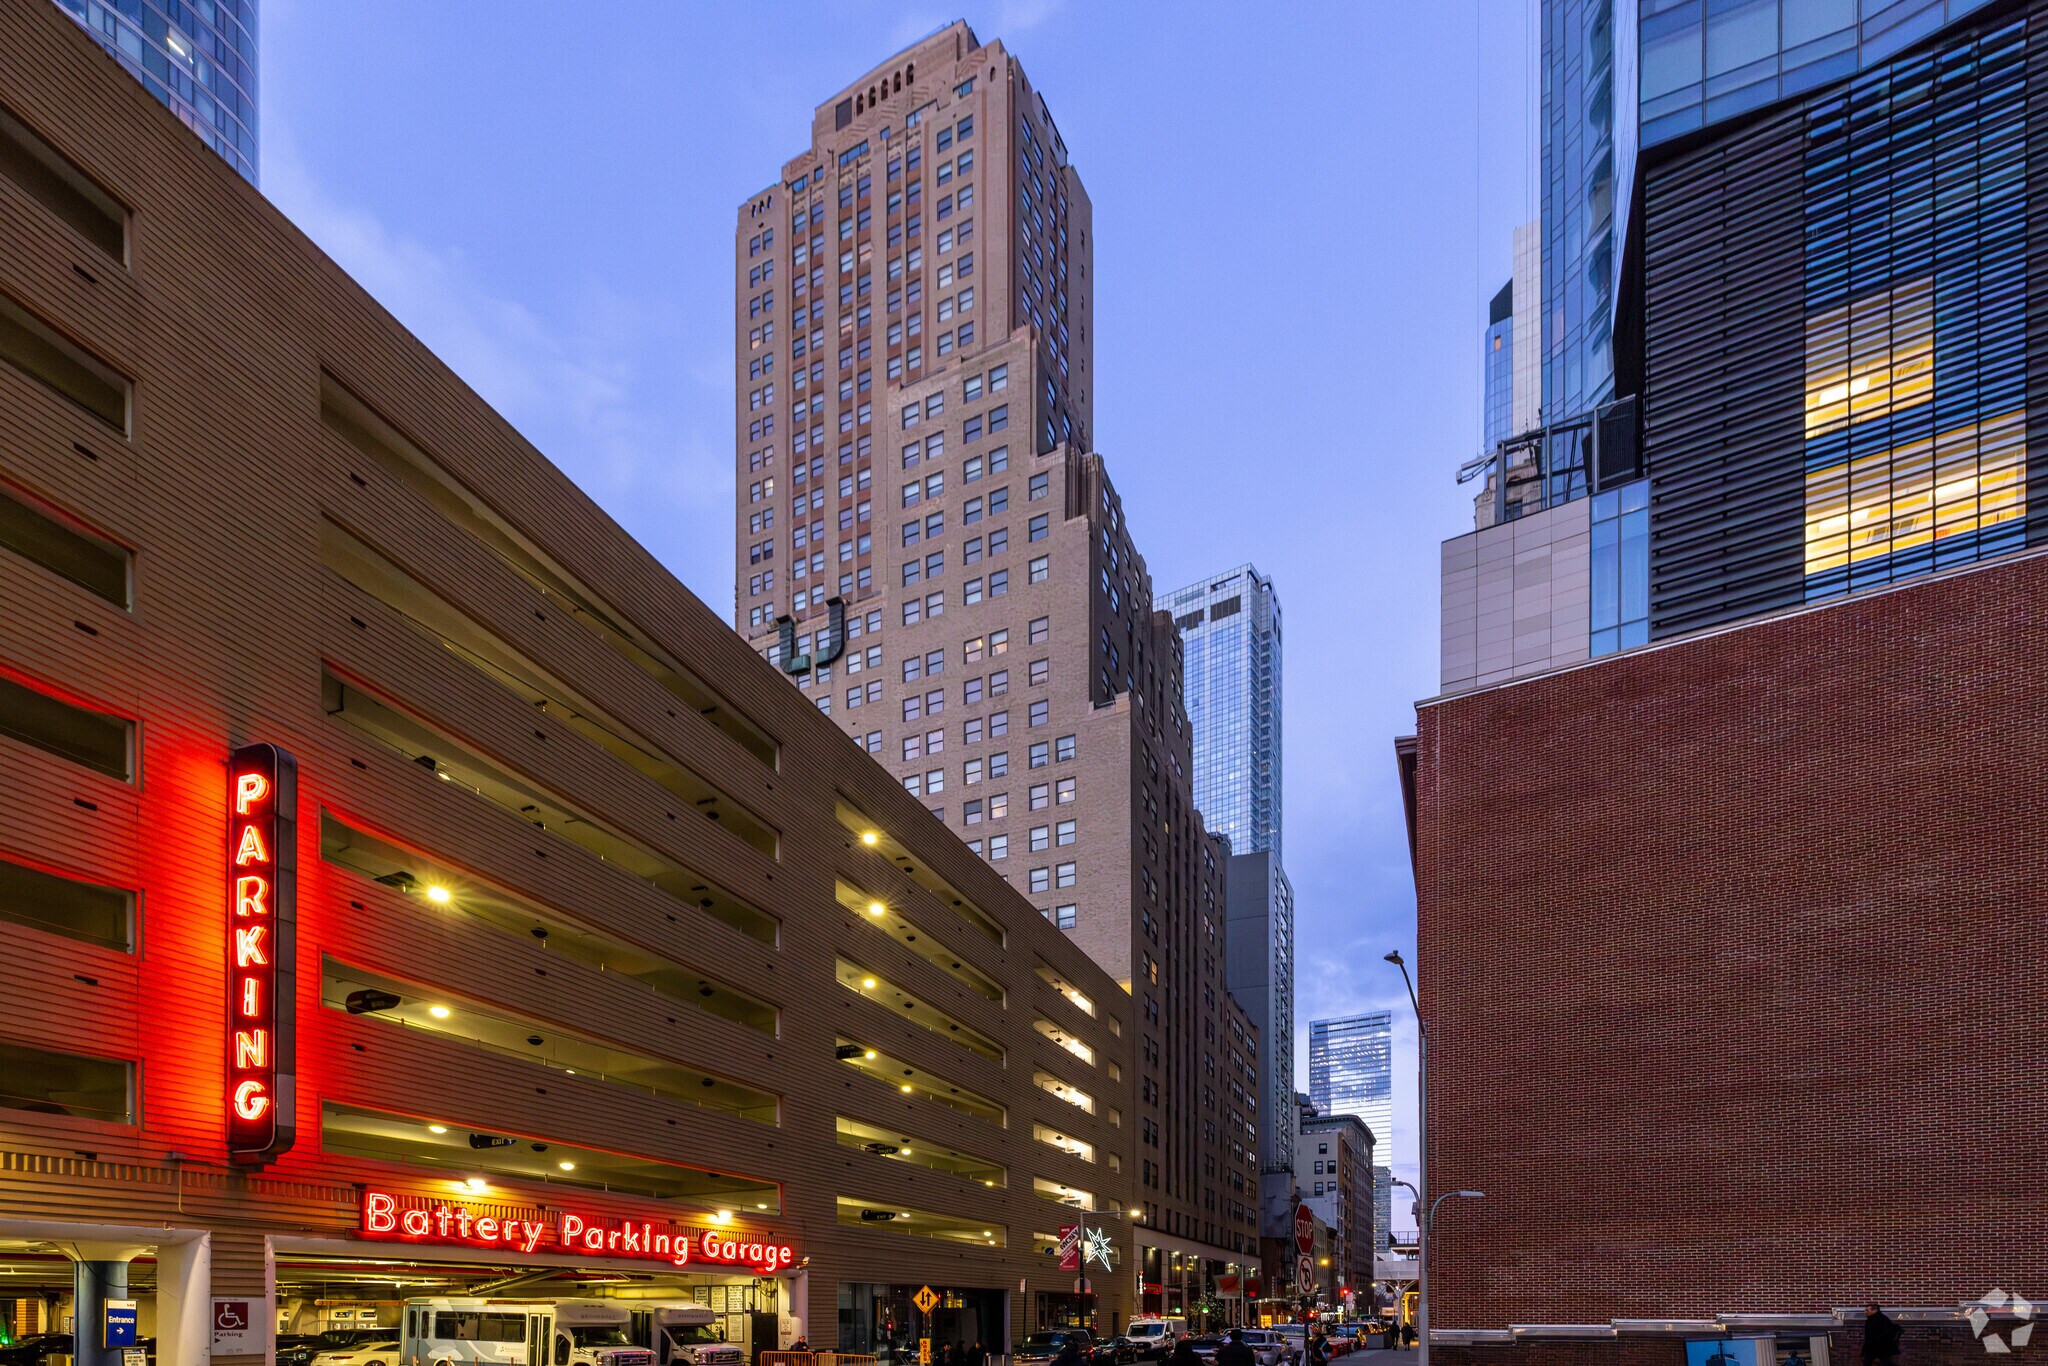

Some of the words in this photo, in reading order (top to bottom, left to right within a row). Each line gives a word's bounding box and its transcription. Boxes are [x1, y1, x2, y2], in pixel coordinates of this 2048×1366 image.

[235, 772, 271, 1121] PARKING
[366, 1191, 544, 1253] Battery
[562, 1214, 689, 1266] Parking
[701, 1230, 793, 1270] Garage
[1296, 1218, 1313, 1239] STOP
[1059, 1229, 1079, 1250] MCNY
[108, 1315, 135, 1324] Entrance
